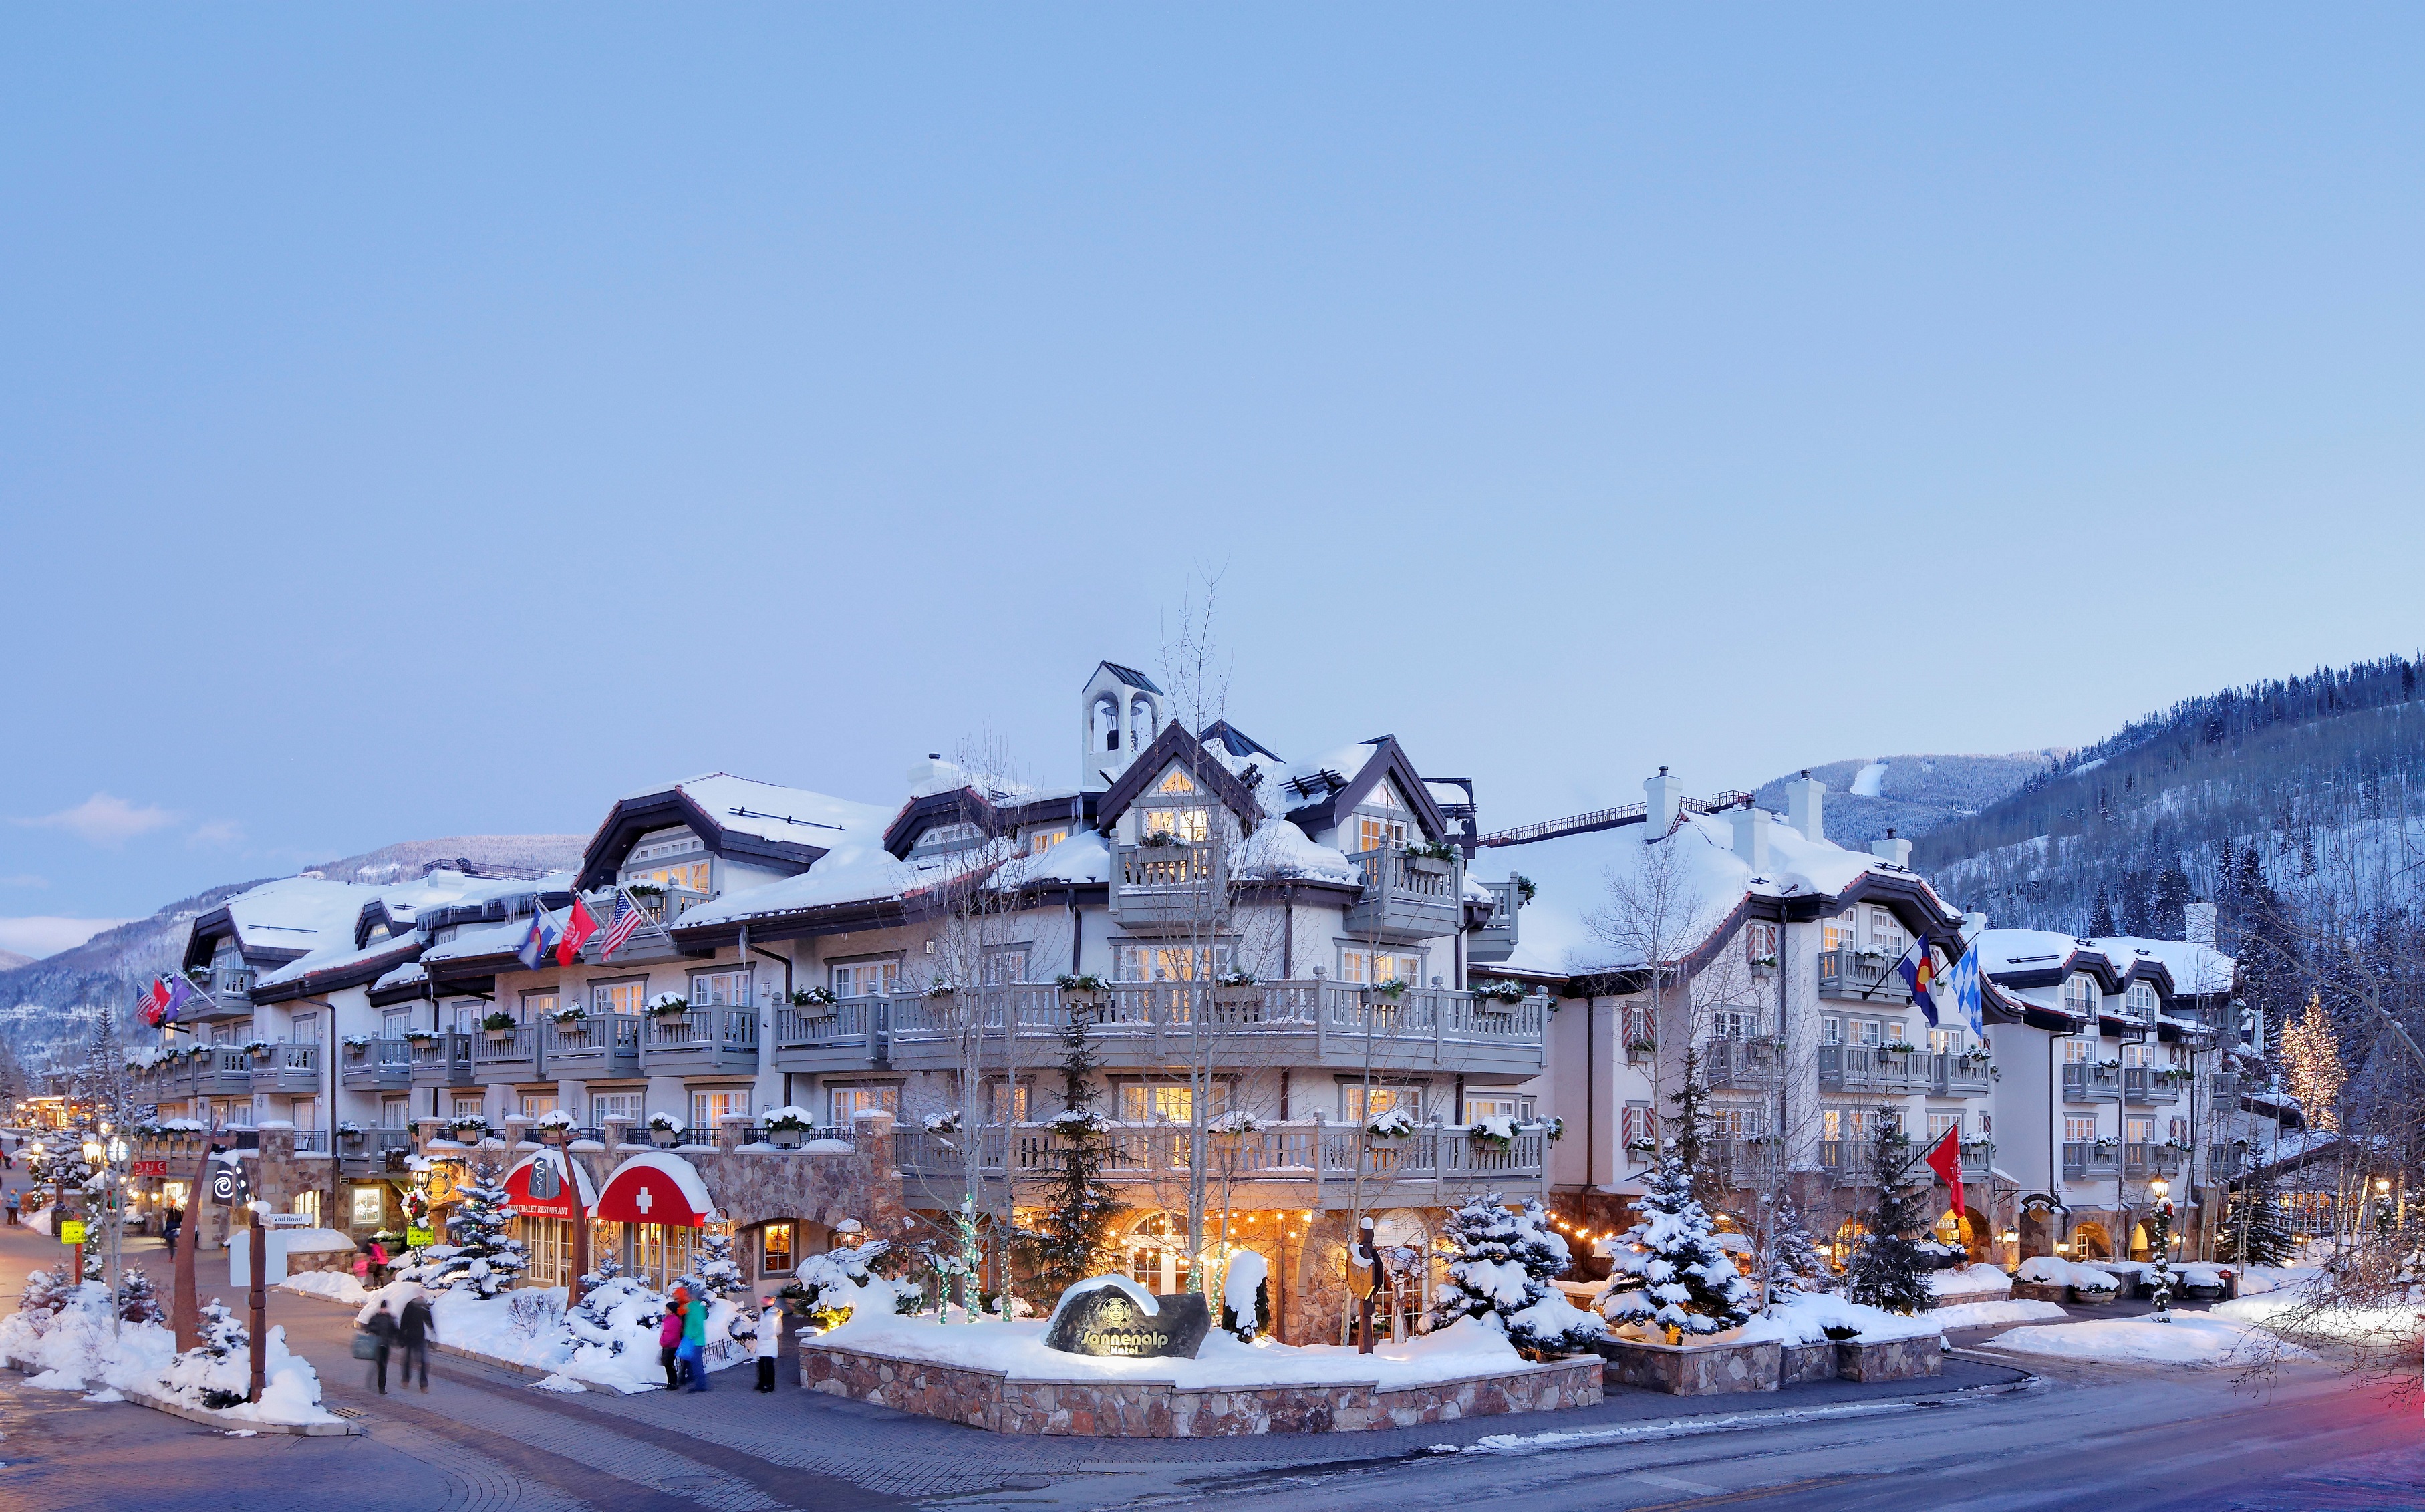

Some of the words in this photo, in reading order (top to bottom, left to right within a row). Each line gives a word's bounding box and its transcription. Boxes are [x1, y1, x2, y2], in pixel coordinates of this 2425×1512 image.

[537, 1207, 568, 1215] RESTAURANT
[1081, 1331, 1169, 1348] Sonnenalp
[1111, 1346, 1138, 1354] Hotel
